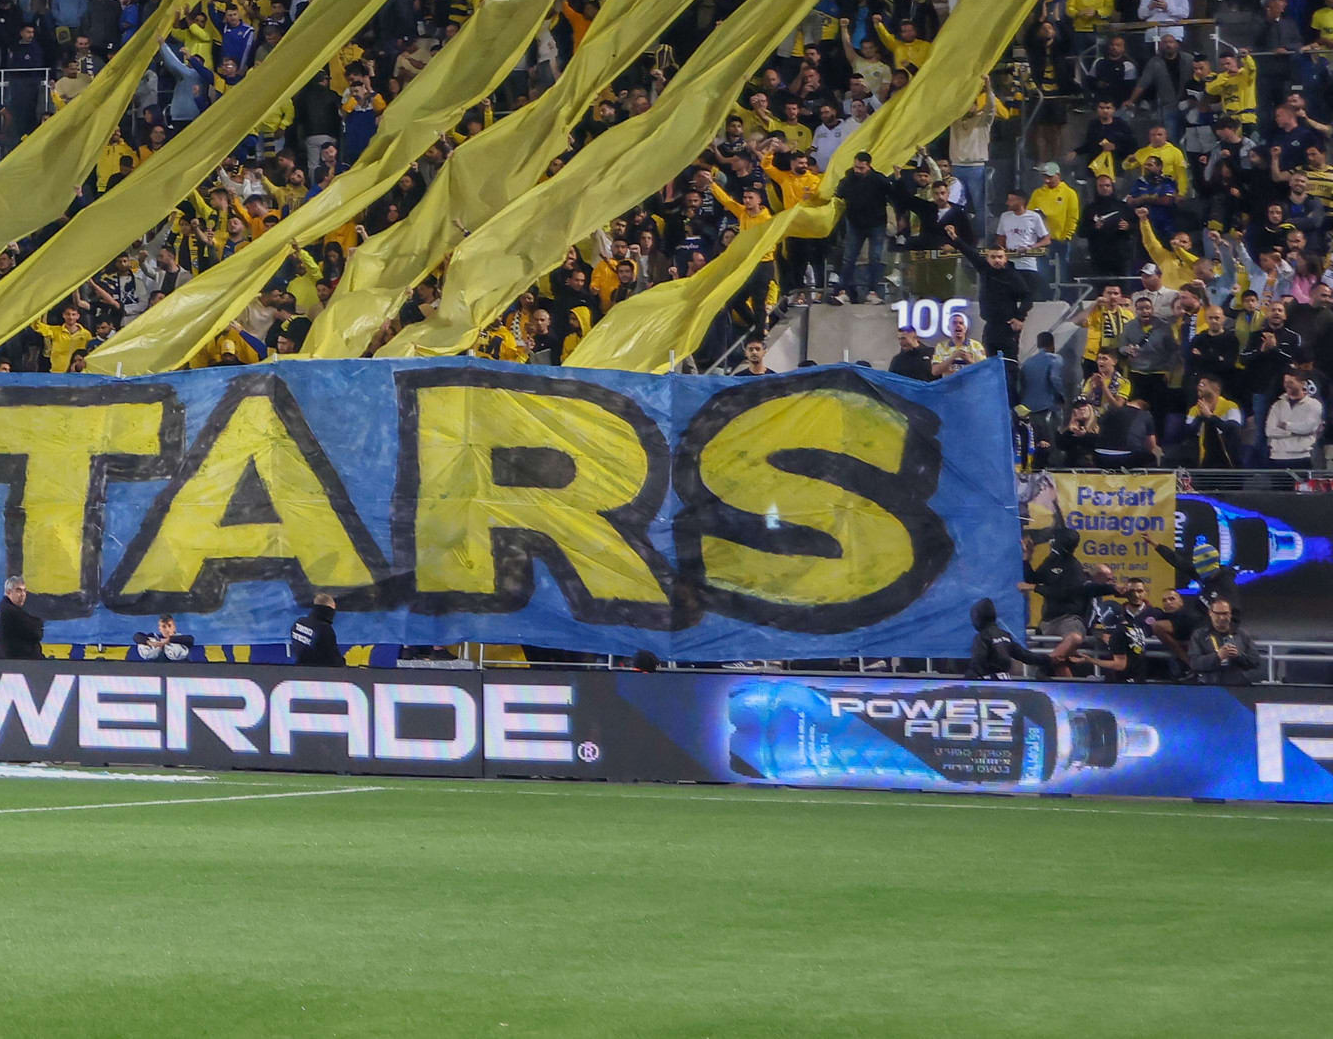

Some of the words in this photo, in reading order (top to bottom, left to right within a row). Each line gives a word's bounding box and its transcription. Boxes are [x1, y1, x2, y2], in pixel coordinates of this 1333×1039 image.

[891, 298, 969, 338] 106
[1076, 485, 1155, 506] Parfait
[1066, 510, 1165, 536] Guiagon
[1083, 539, 1127, 556] Gate
[1133, 541, 1149, 556] 11
[829, 697, 1018, 719] POWER
[904, 718, 1013, 742] ADE
